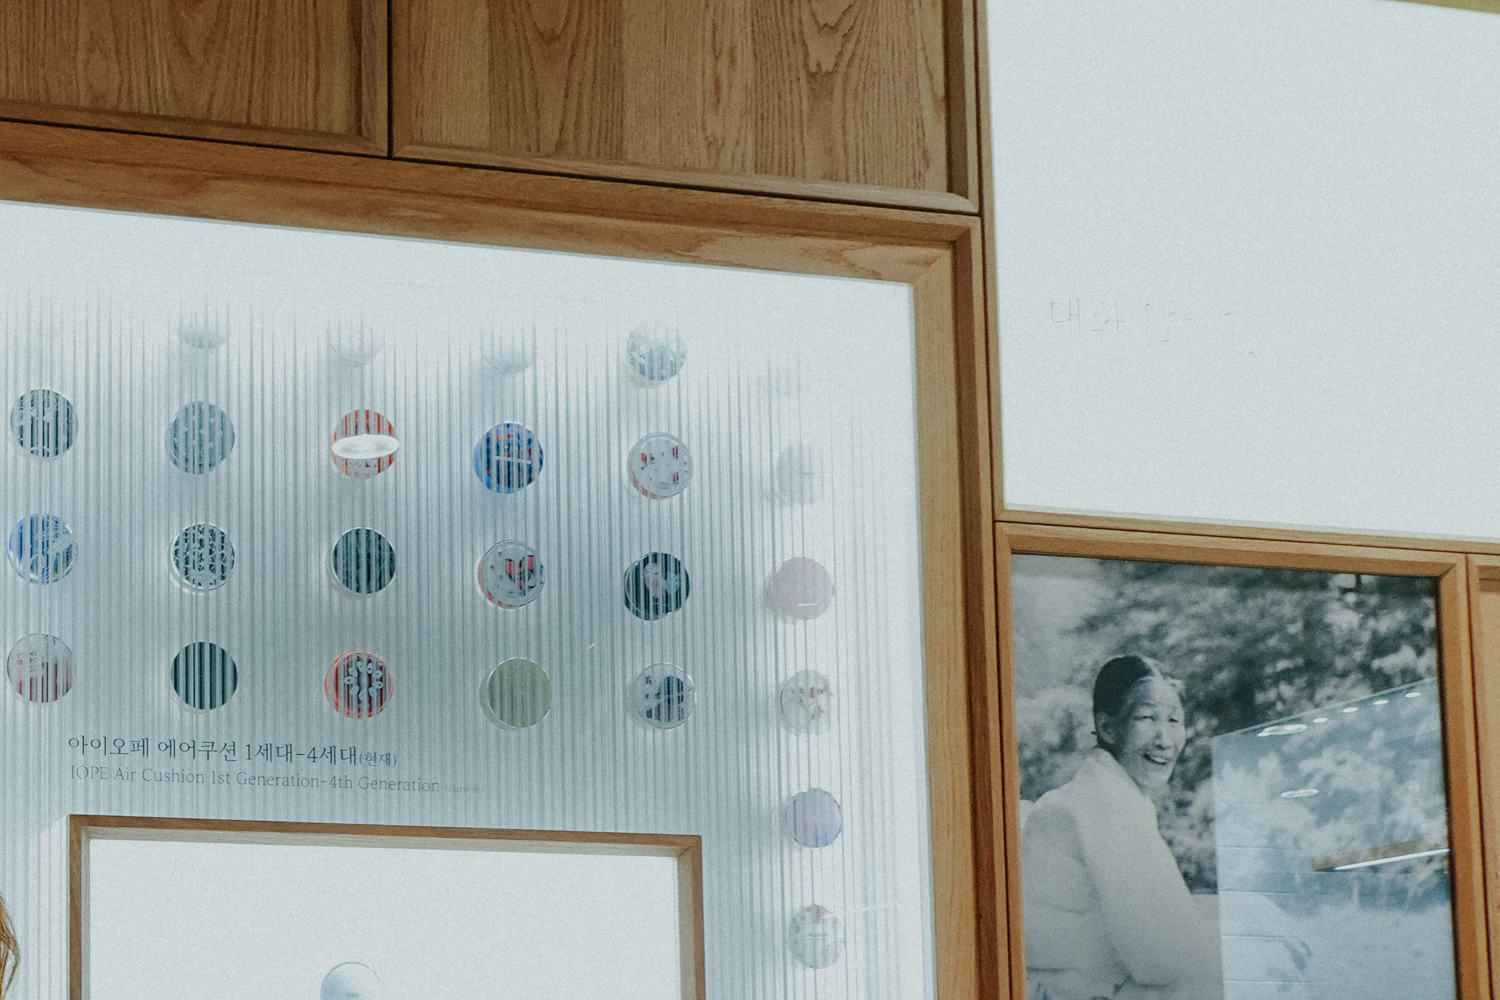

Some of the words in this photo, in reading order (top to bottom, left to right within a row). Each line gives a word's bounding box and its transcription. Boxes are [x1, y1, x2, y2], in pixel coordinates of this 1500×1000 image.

[68, 734, 149, 758] 아이오페
[157, 738, 237, 762] 에어쿠션
[71, 765, 109, 780] IOPE
[114, 767, 137, 781] Air
[141, 767, 204, 784] Cushion
[210, 770, 231, 785] 1st
[236, 771, 353, 789] Generation-4th
[358, 775, 440, 793] Generation
